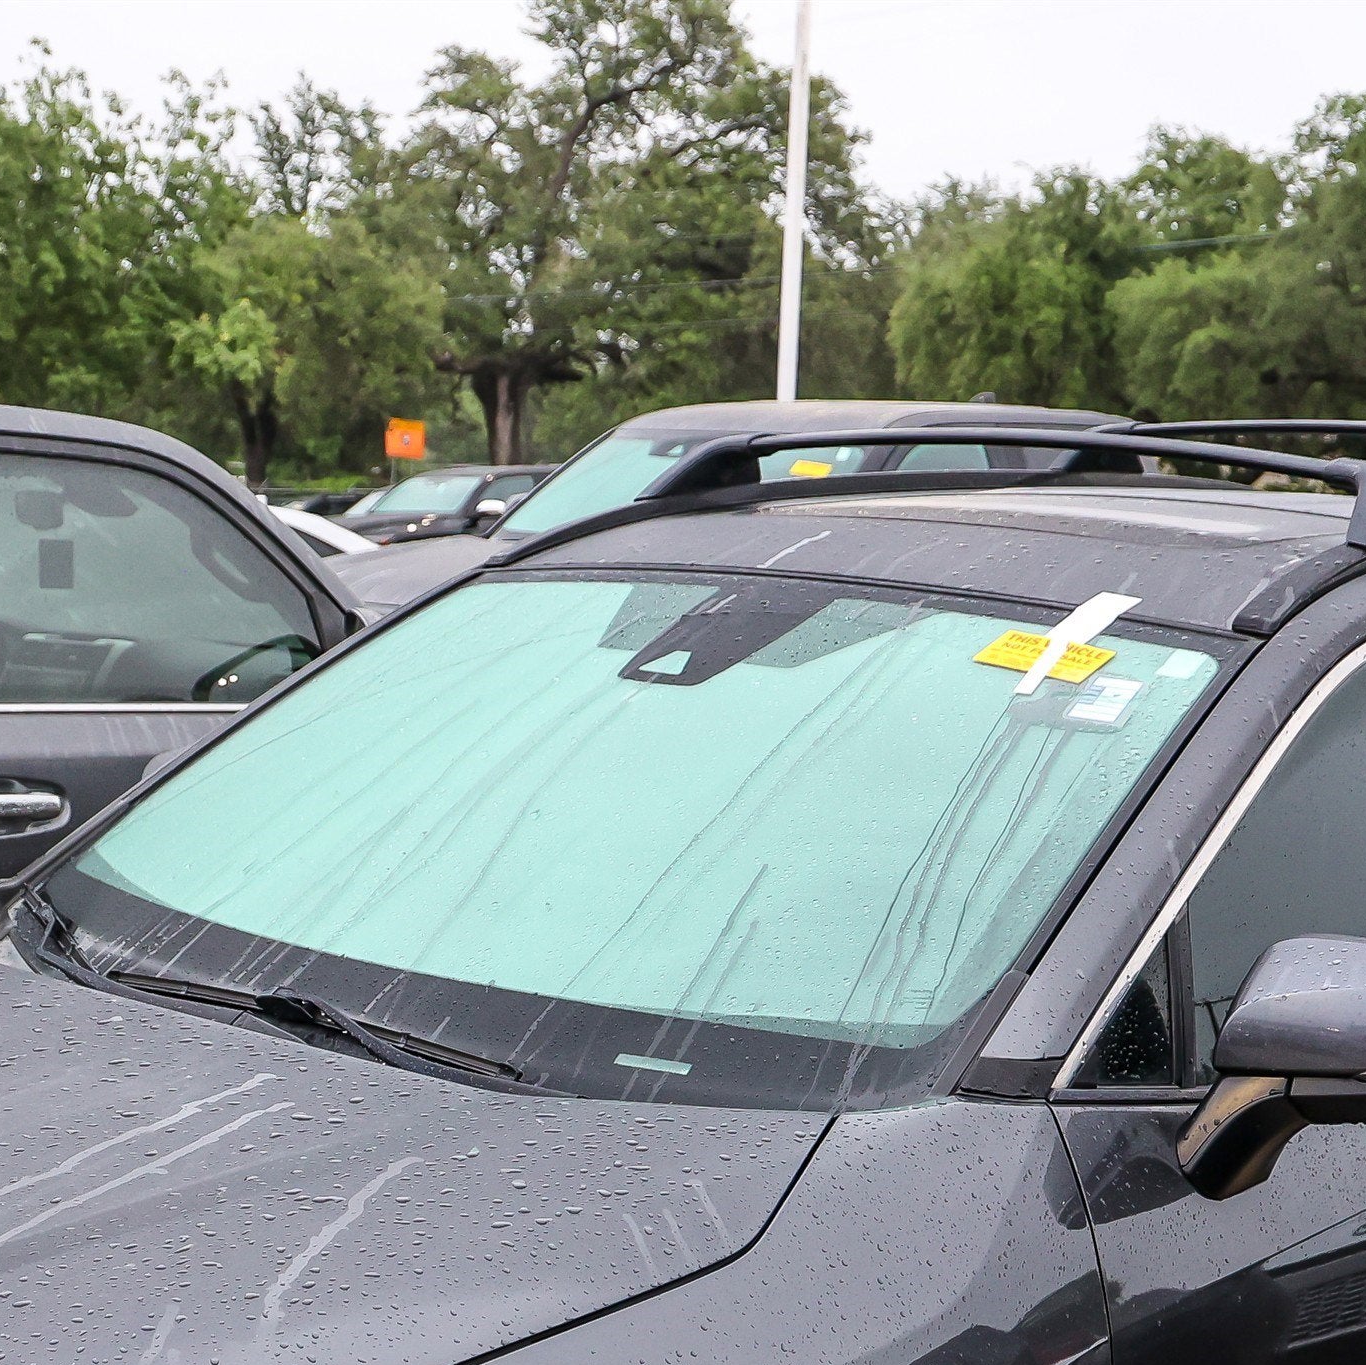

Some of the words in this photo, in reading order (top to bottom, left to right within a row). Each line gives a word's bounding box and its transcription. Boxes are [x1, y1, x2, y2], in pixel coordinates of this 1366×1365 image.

[1001, 641, 1029, 651] NOT
[1059, 653, 1094, 666] SALE
[1008, 633, 1042, 646] THIS
[1044, 639, 1109, 660] VHICLE
